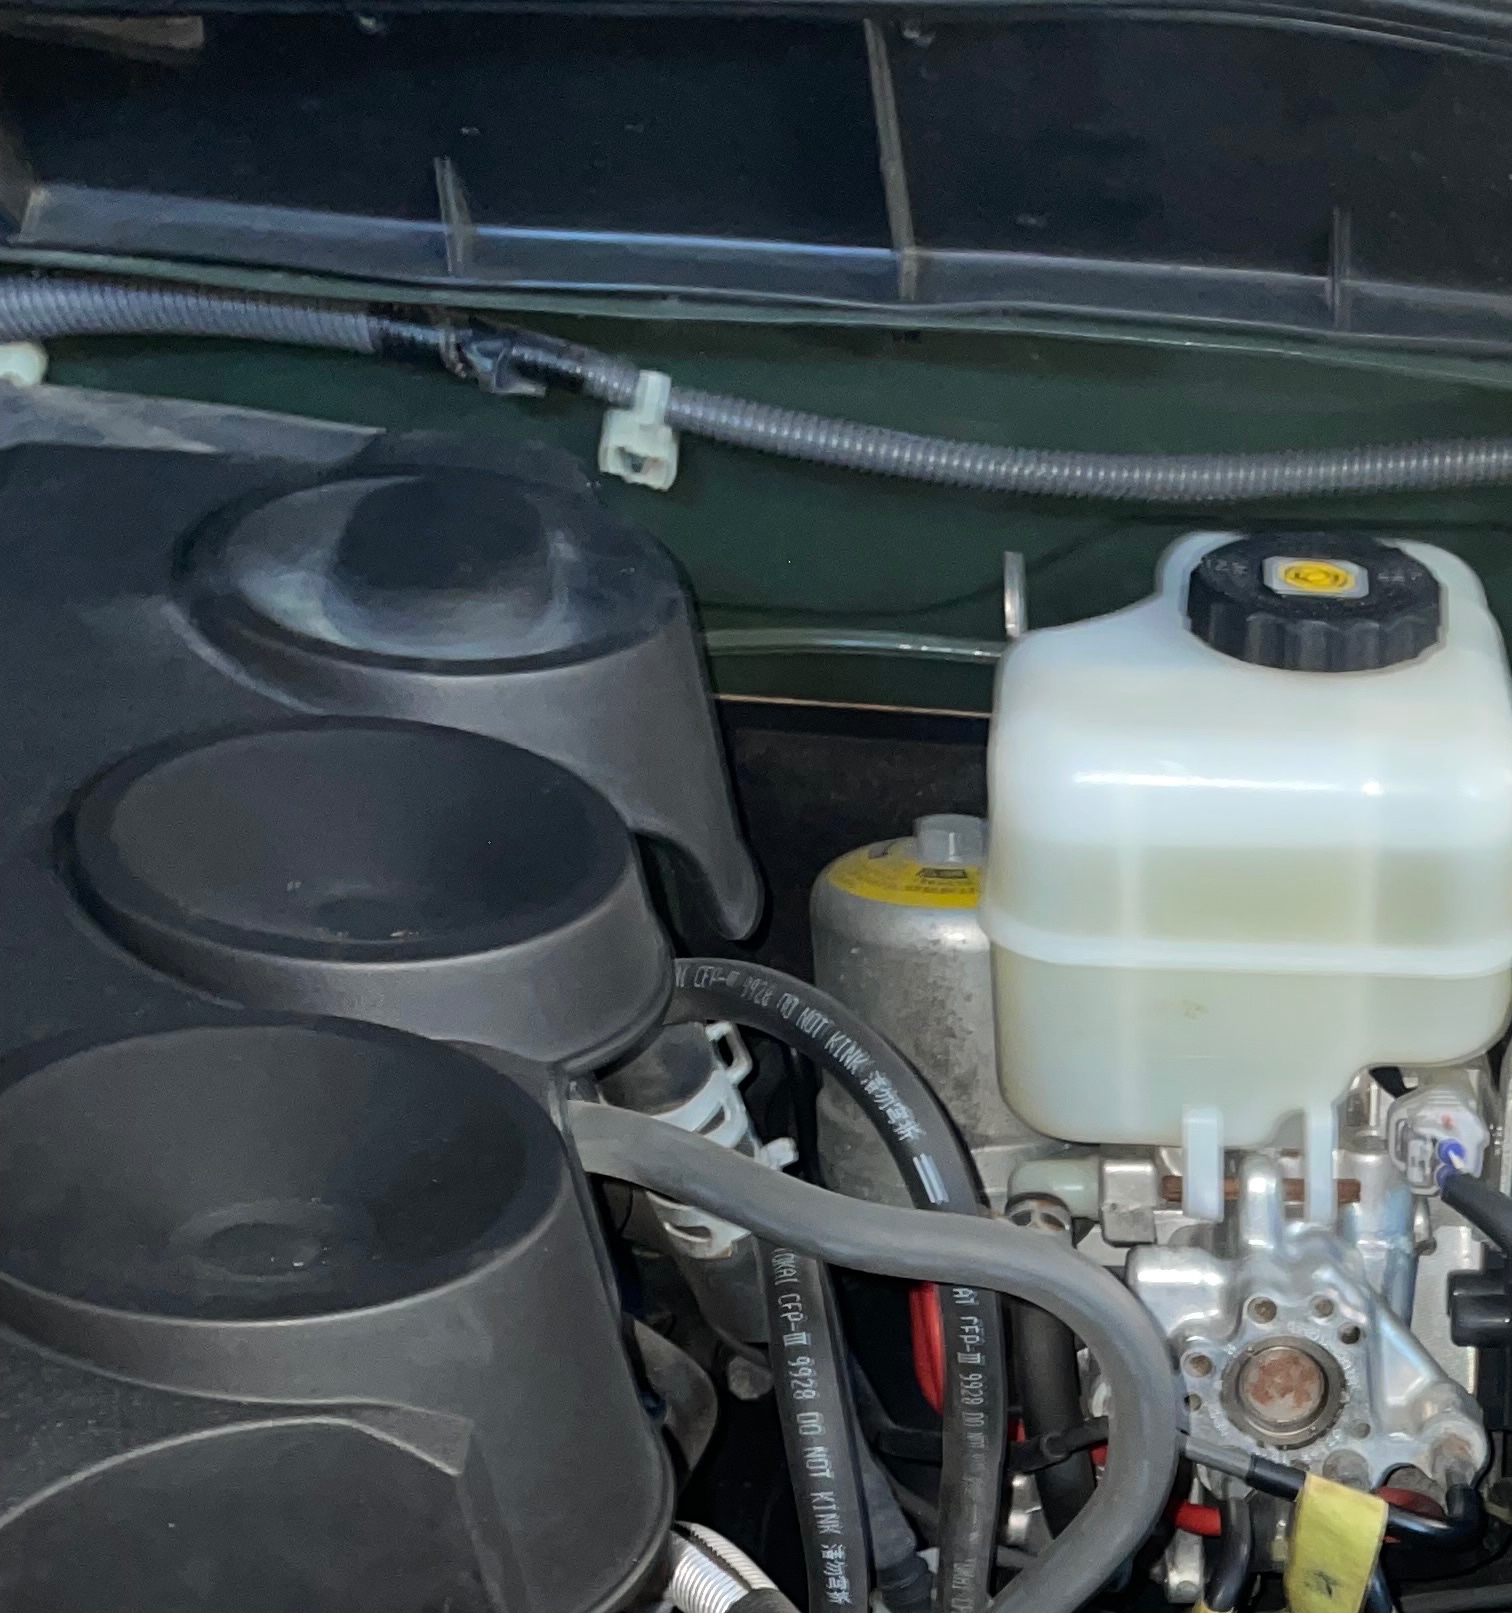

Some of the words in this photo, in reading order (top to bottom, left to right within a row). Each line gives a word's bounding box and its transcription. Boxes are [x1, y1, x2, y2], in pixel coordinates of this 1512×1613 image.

[824, 1031, 874, 1075] KINK
[785, 1356, 818, 1401] 9928
[797, 1412, 825, 1437] DO
[802, 1447, 834, 1481] NOT
[810, 1491, 842, 1536] KINK
